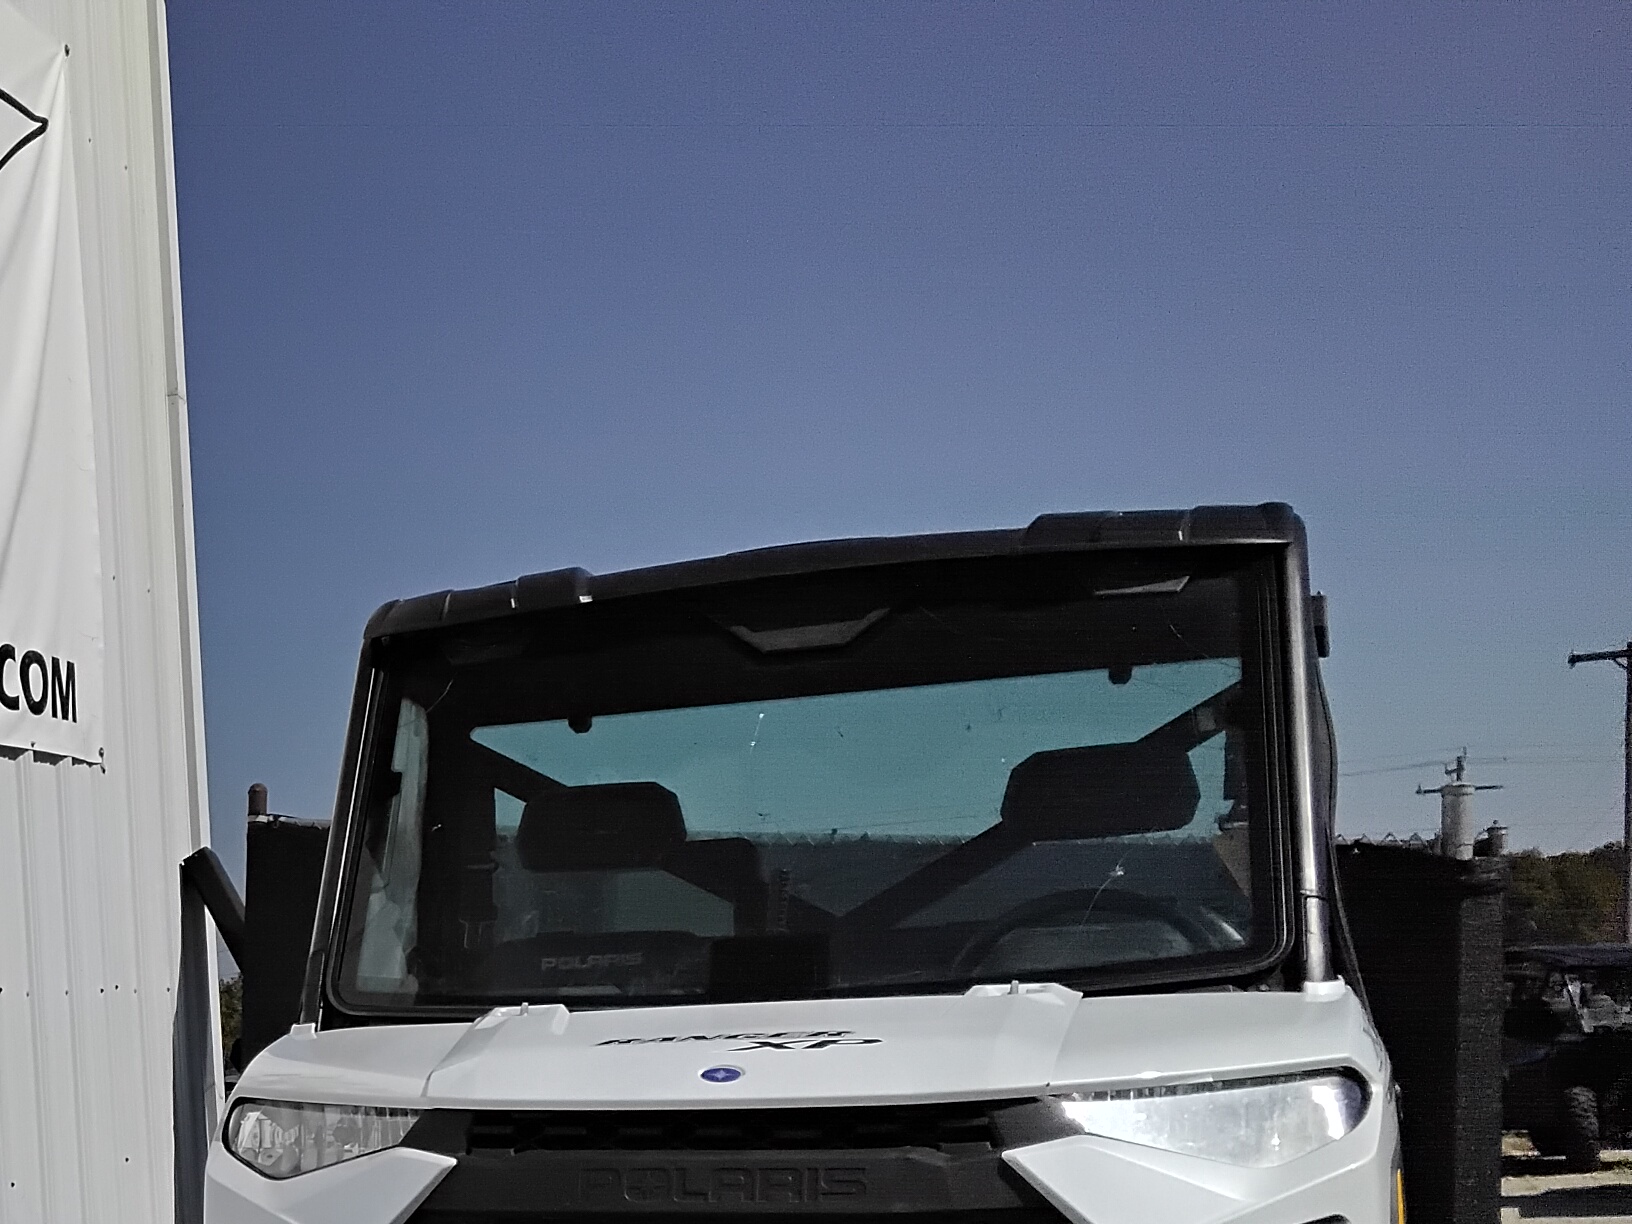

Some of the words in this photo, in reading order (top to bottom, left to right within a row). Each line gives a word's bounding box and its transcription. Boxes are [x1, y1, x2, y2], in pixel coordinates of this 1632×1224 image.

[541, 953, 642, 971] POLARIS
[726, 1038, 883, 1052] XP
[578, 1166, 867, 1203] POLARIS
